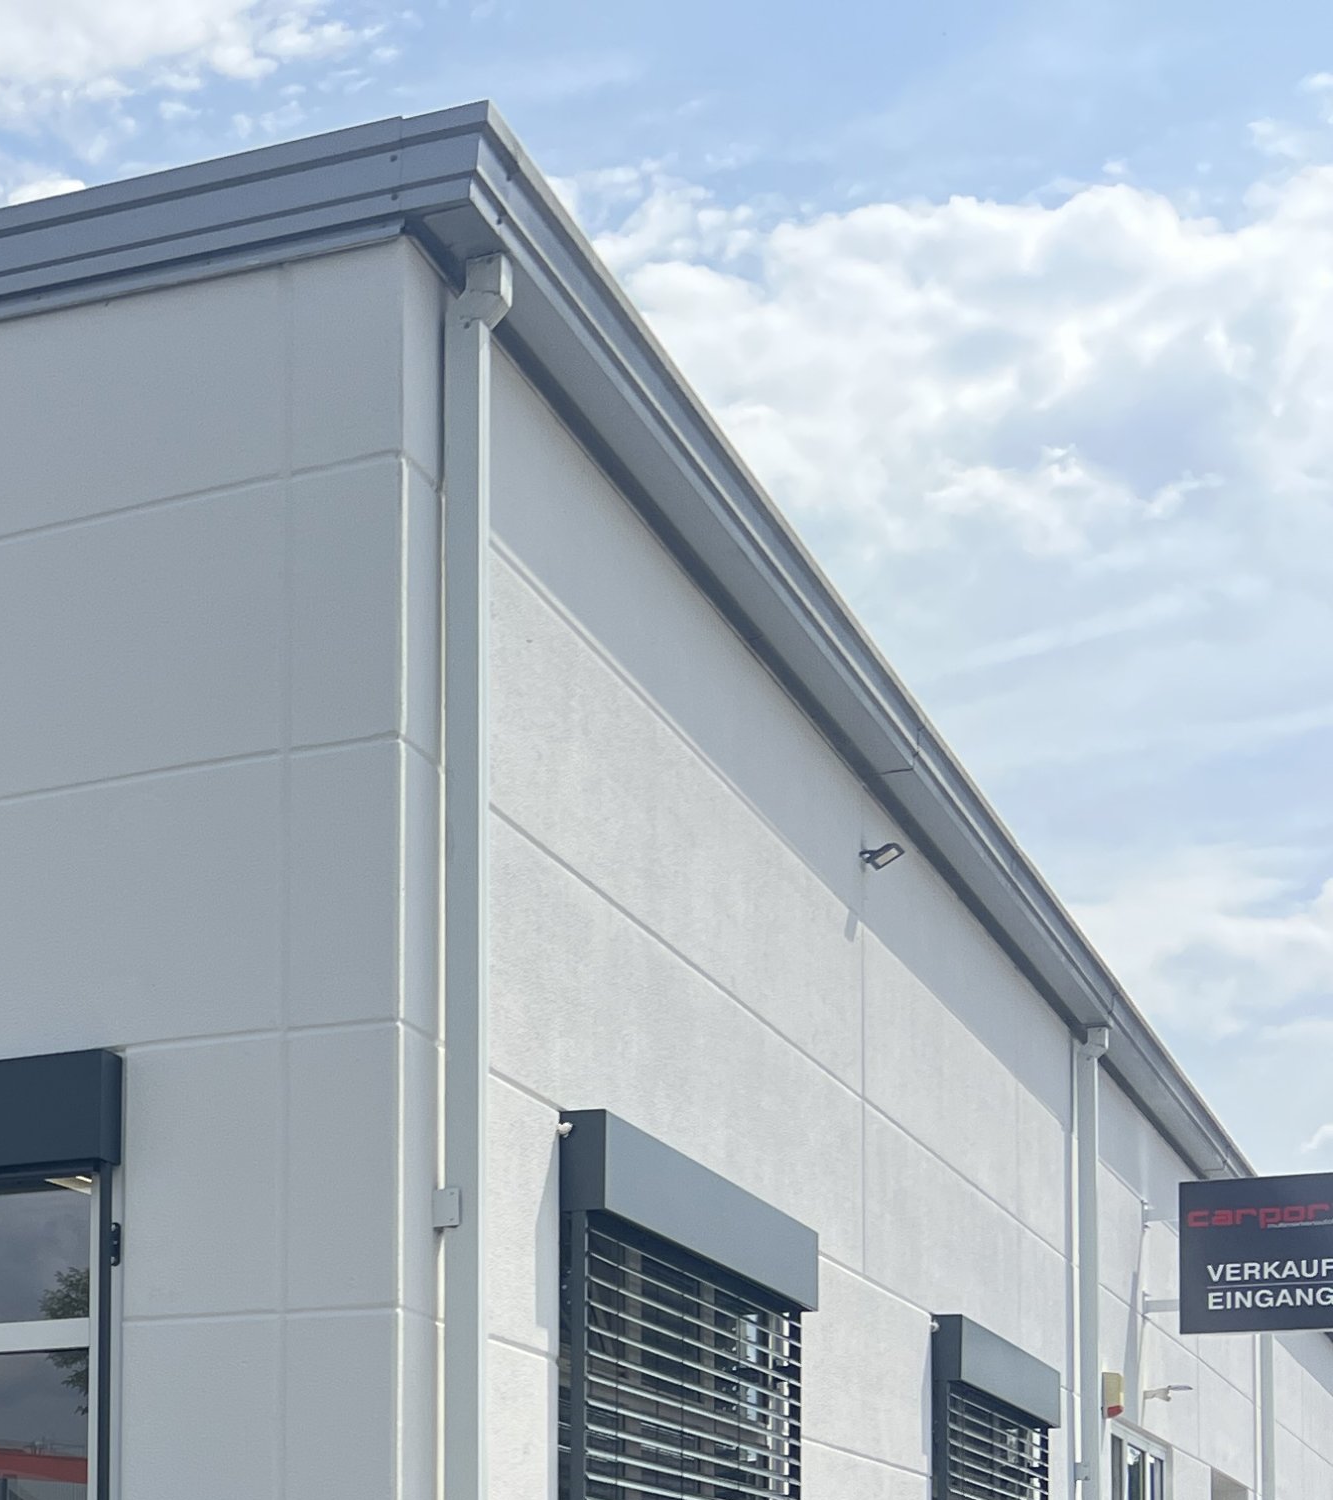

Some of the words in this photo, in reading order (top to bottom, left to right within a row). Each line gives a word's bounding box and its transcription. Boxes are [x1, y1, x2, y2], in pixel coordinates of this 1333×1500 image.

[1187, 1202, 1333, 1230] carpor
[1206, 1258, 1333, 1282] VERKAUF
[1208, 1286, 1333, 1310] EINGANG
